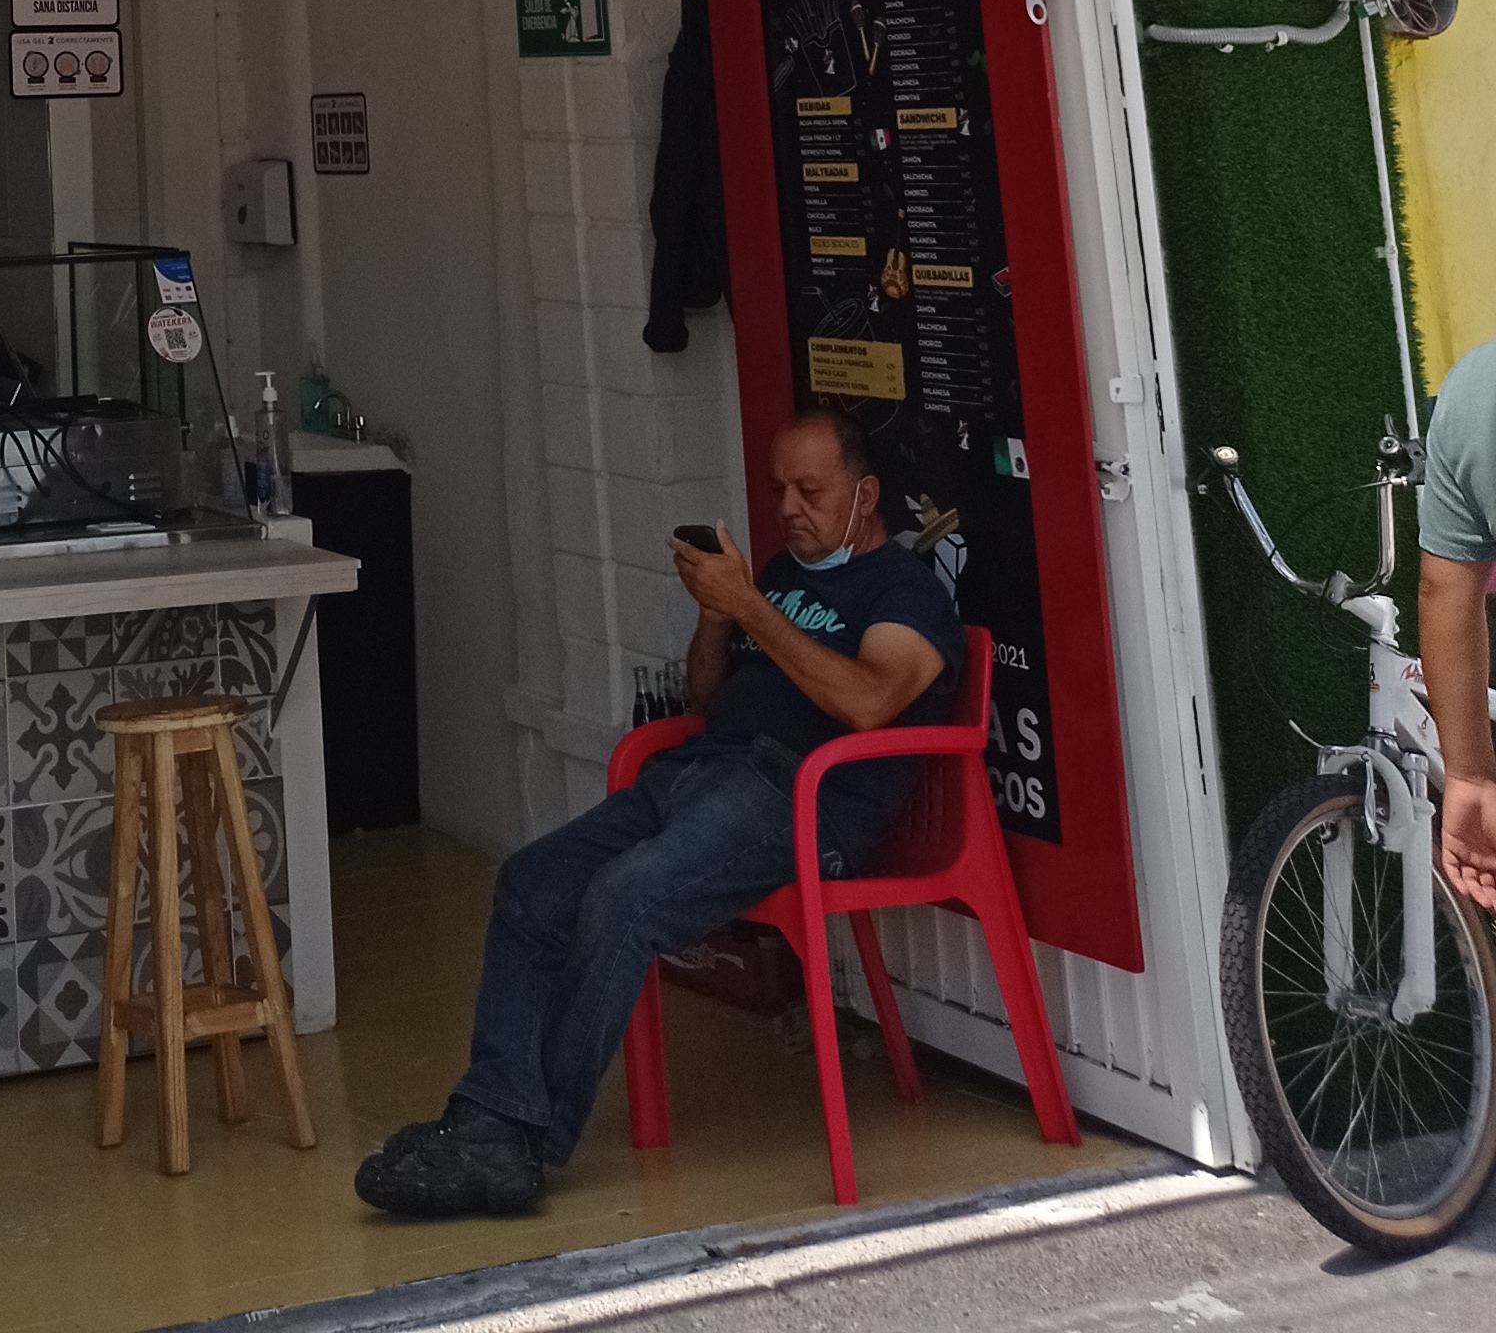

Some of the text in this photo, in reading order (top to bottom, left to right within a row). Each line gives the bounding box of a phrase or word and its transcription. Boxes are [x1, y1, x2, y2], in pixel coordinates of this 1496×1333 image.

[33, 0, 98, 13] SANA DISTANCIA
[799, 102, 831, 111] BEBIDAS
[900, 113, 946, 124] SANDWICHS
[805, 168, 849, 177] MALTEADAS
[915, 269, 970, 281] QUESADILLAS
[150, 316, 192, 328] WATEKERS
[811, 343, 867, 356] COMPLEMENTOS
[992, 640, 1029, 670] 2021
